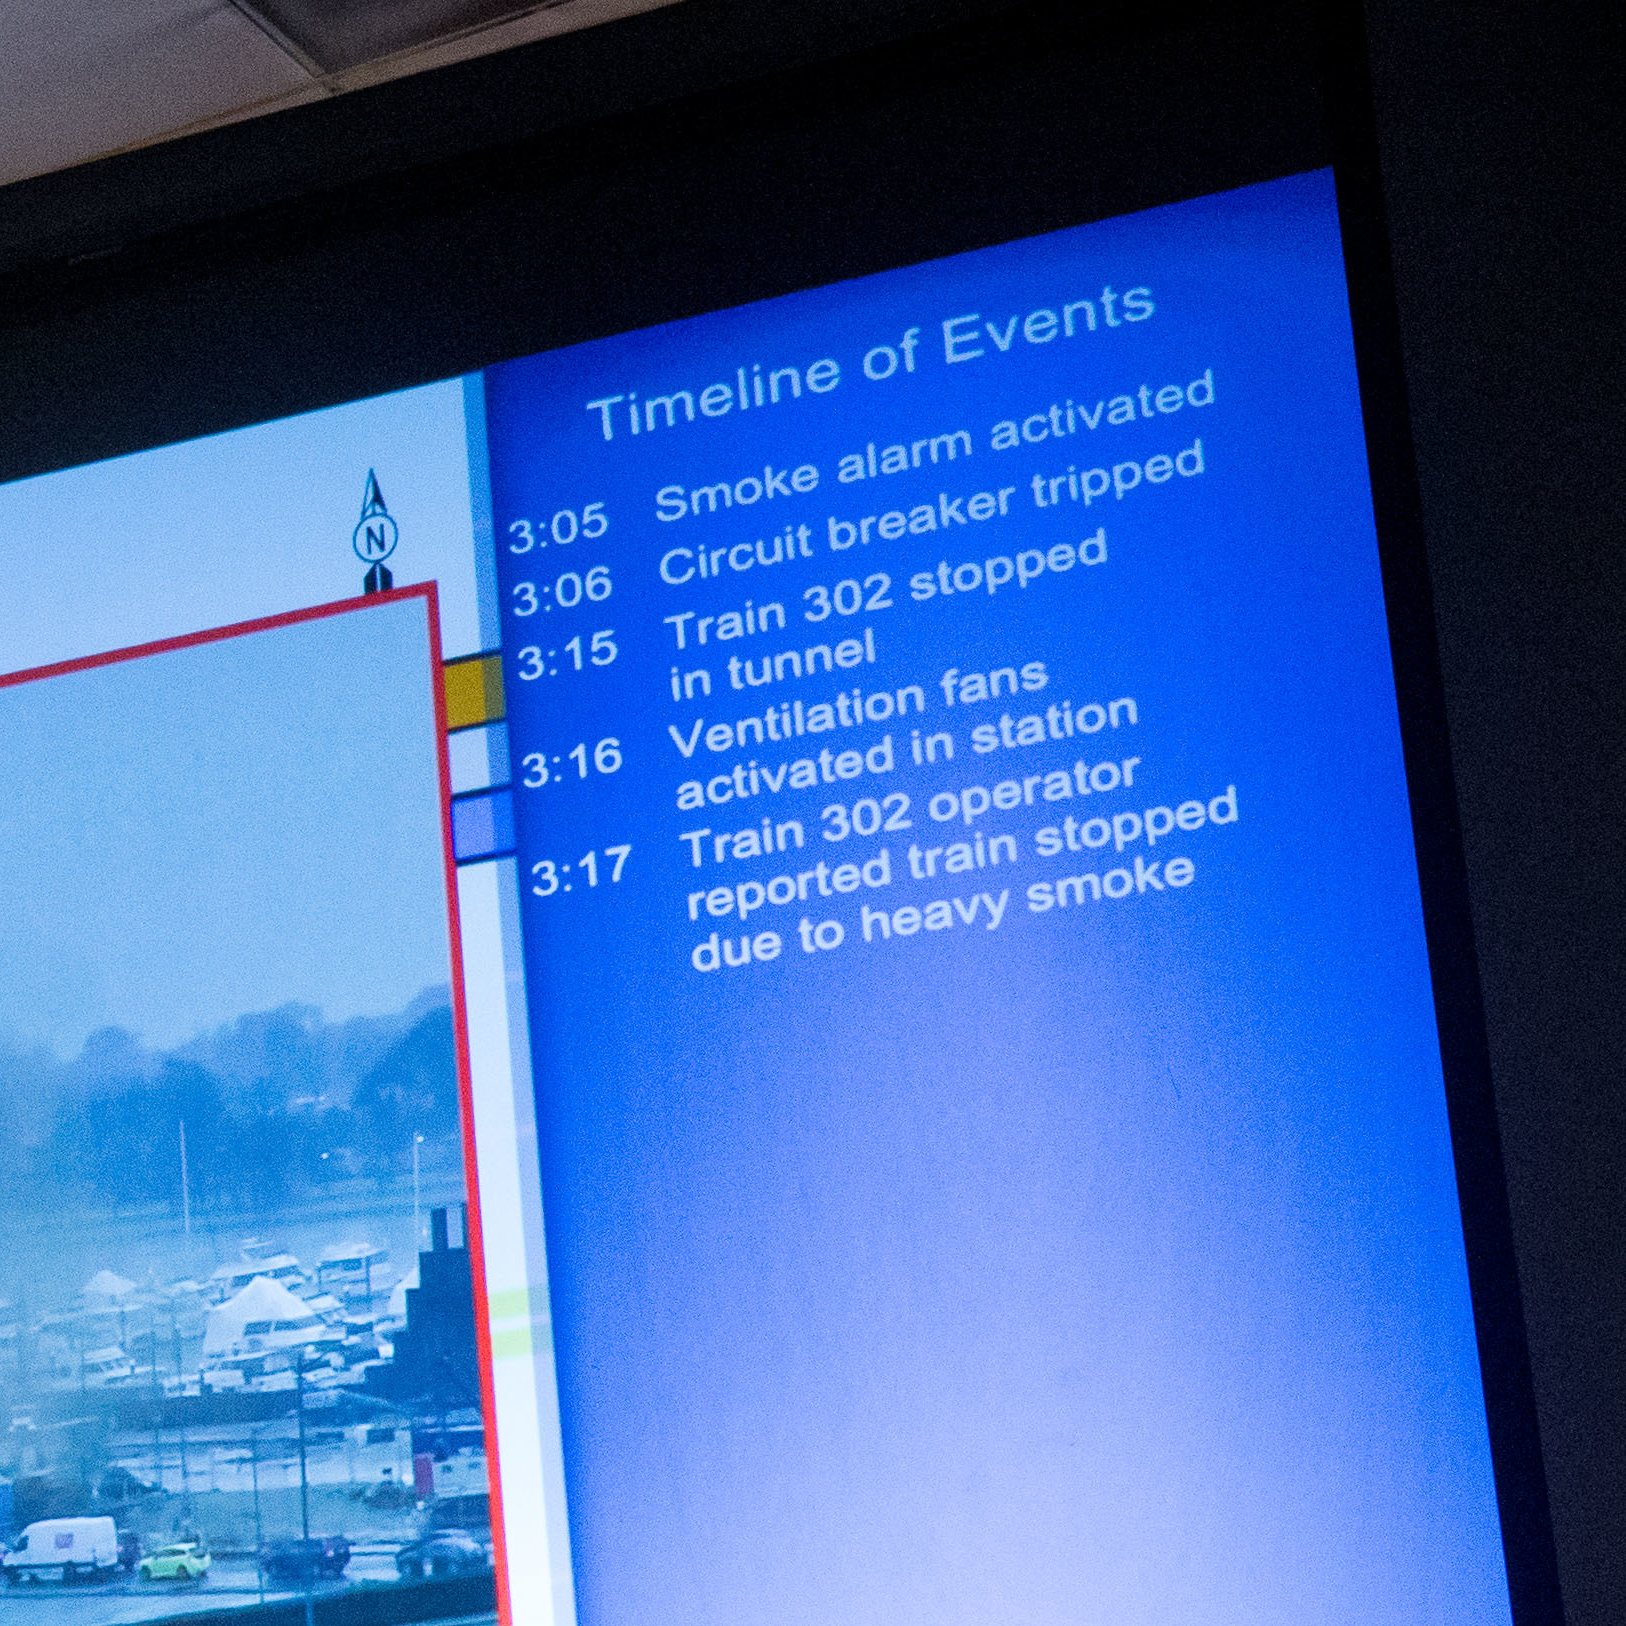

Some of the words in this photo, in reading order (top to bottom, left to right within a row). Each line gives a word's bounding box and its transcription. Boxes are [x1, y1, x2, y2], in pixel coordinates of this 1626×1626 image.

[586, 355, 841, 442] Timeline
[863, 327, 920, 381] of
[944, 281, 1156, 366] Events
[509, 502, 609, 554] 3:05
[655, 458, 820, 524] Smoke
[837, 427, 974, 485] alarm
[991, 370, 1216, 450] activated
[513, 567, 613, 617] 3:06
[659, 524, 813, 586] Circuit
[828, 483, 1014, 550] breaker
[1031, 439, 1206, 514] tripped
[367, 524, 385, 554] N
[517, 630, 619, 681] 3:15
[664, 598, 786, 651] Train
[803, 573, 894, 619] 302
[909, 528, 1109, 604] stopped
[522, 739, 624, 790] 3:16
[669, 681, 925, 759] Ventilation
[940, 657, 1049, 706] fans
[670, 662, 713, 702] in
[728, 627, 877, 690] tunnel
[676, 734, 895, 811] activated
[913, 727, 953, 767] in
[971, 691, 1139, 755] station
[531, 845, 632, 898] 3:17
[680, 817, 806, 868] Train
[821, 792, 913, 838] 302
[929, 752, 1142, 829] operator
[688, 853, 892, 924] reported
[909, 831, 1018, 878] train
[1034, 786, 1239, 862] stopped
[692, 925, 782, 972] due
[799, 911, 845, 952] to
[862, 880, 1009, 944] heavy
[1027, 855, 1196, 914] smoke
